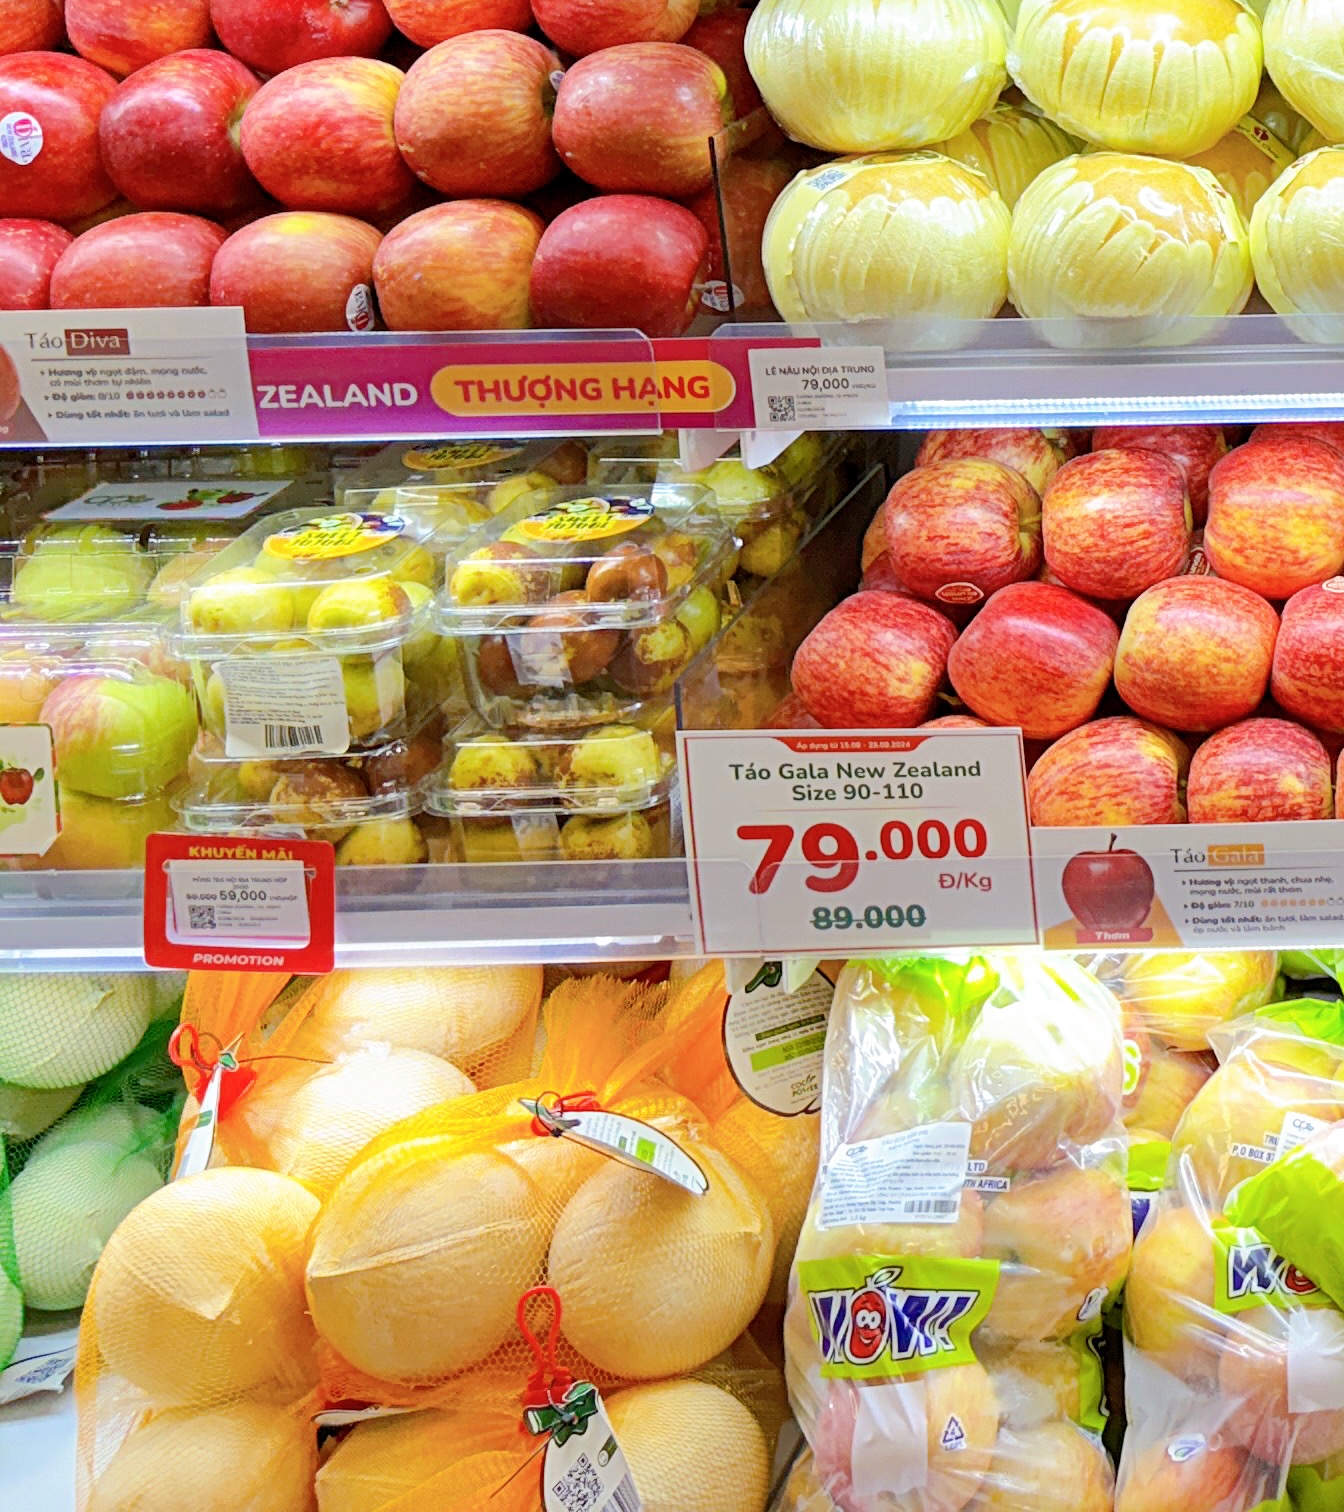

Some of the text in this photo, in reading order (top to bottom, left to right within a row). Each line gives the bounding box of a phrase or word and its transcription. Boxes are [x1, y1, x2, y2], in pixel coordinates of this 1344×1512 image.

[24, 330, 121, 351] Táo Diva
[258, 373, 712, 409] ZEALAND THƯỢNG HẠNG
[800, 377, 850, 393] 79,000
[728, 760, 982, 782] Táo Gala New Zealand
[791, 782, 924, 802] Size 90-110
[736, 819, 988, 895] 79.000
[938, 872, 993, 892] Đ/Kg
[219, 890, 267, 903] 59,000
[809, 904, 927, 930] 89.000
[192, 952, 285, 967] PROMOTION
